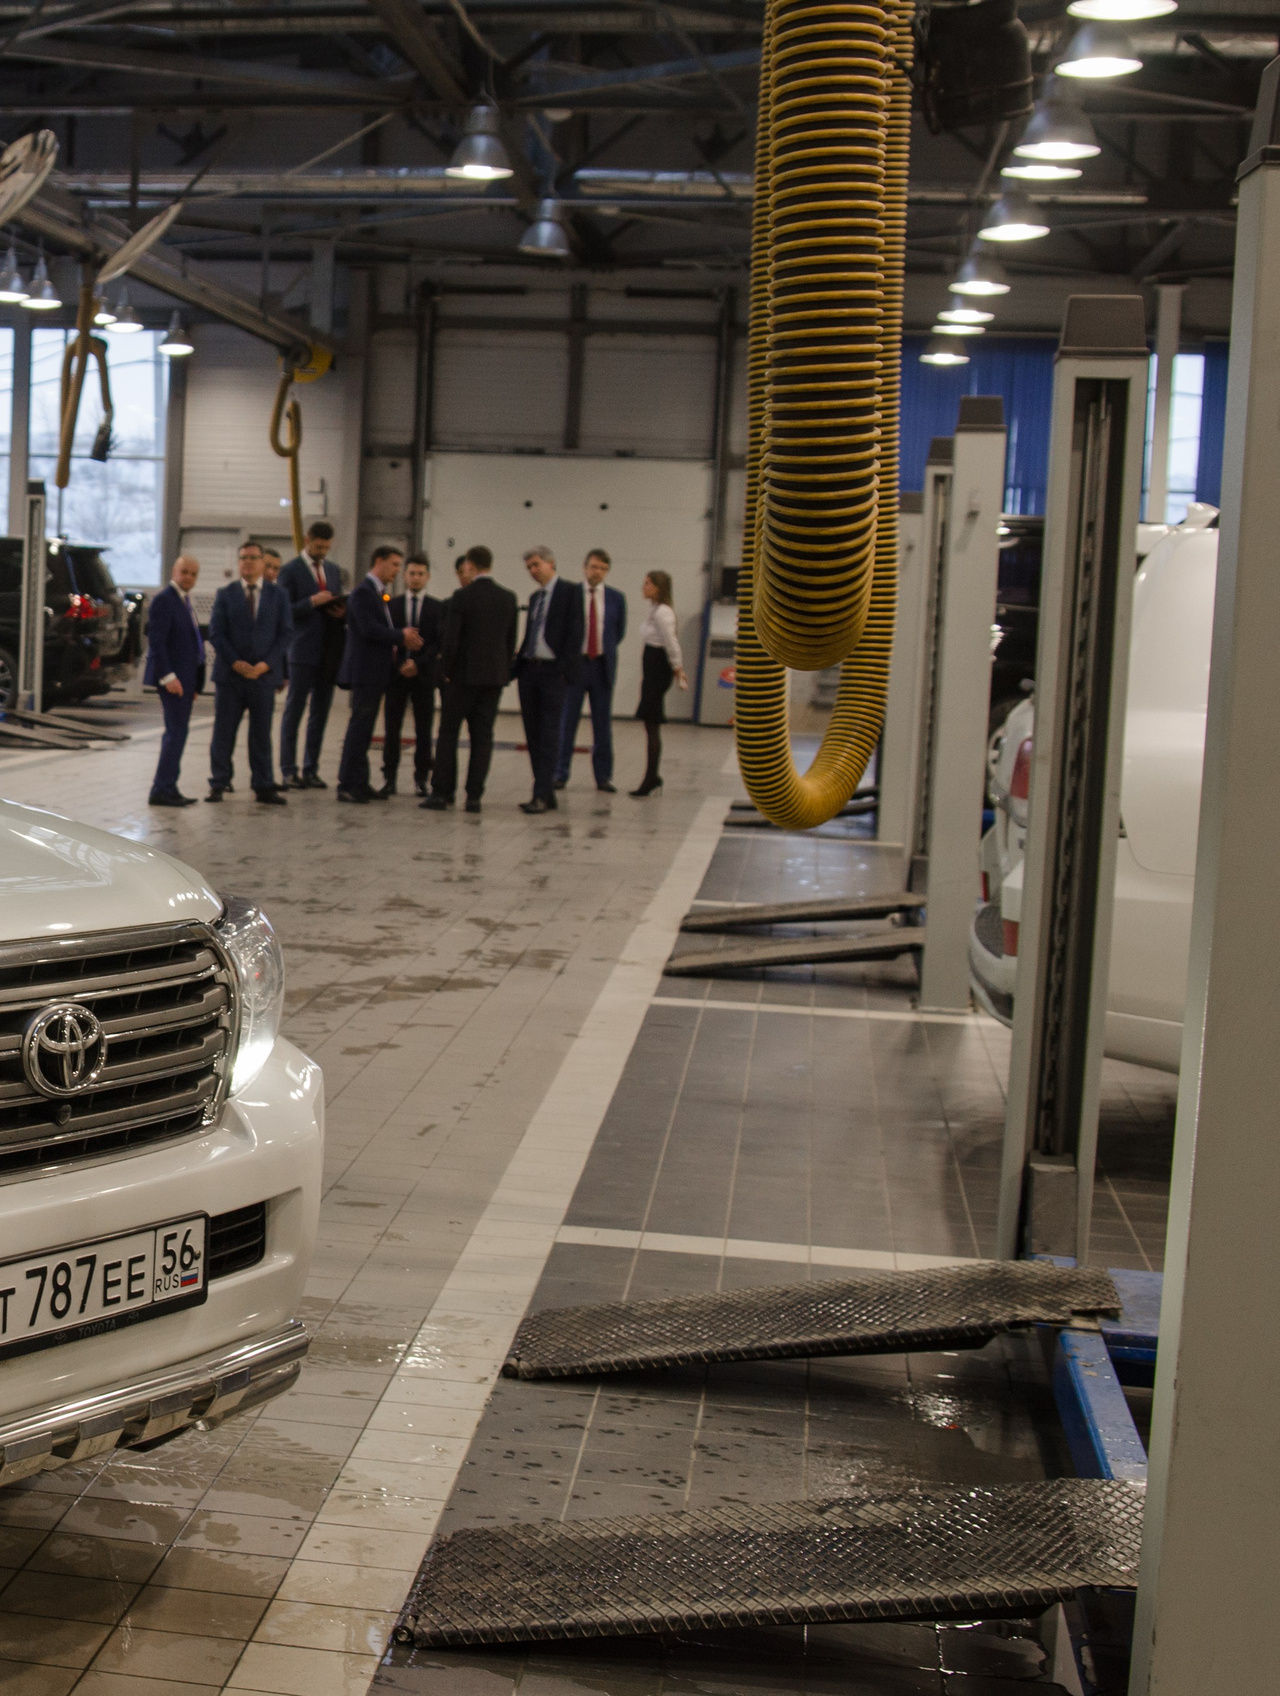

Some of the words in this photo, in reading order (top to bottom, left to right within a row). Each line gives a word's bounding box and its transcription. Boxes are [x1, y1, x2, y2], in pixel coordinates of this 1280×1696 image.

[162, 1228, 195, 1275] 56
[155, 1274, 179, 1294] RUS
[78, 1319, 117, 1338] TOYOTA
